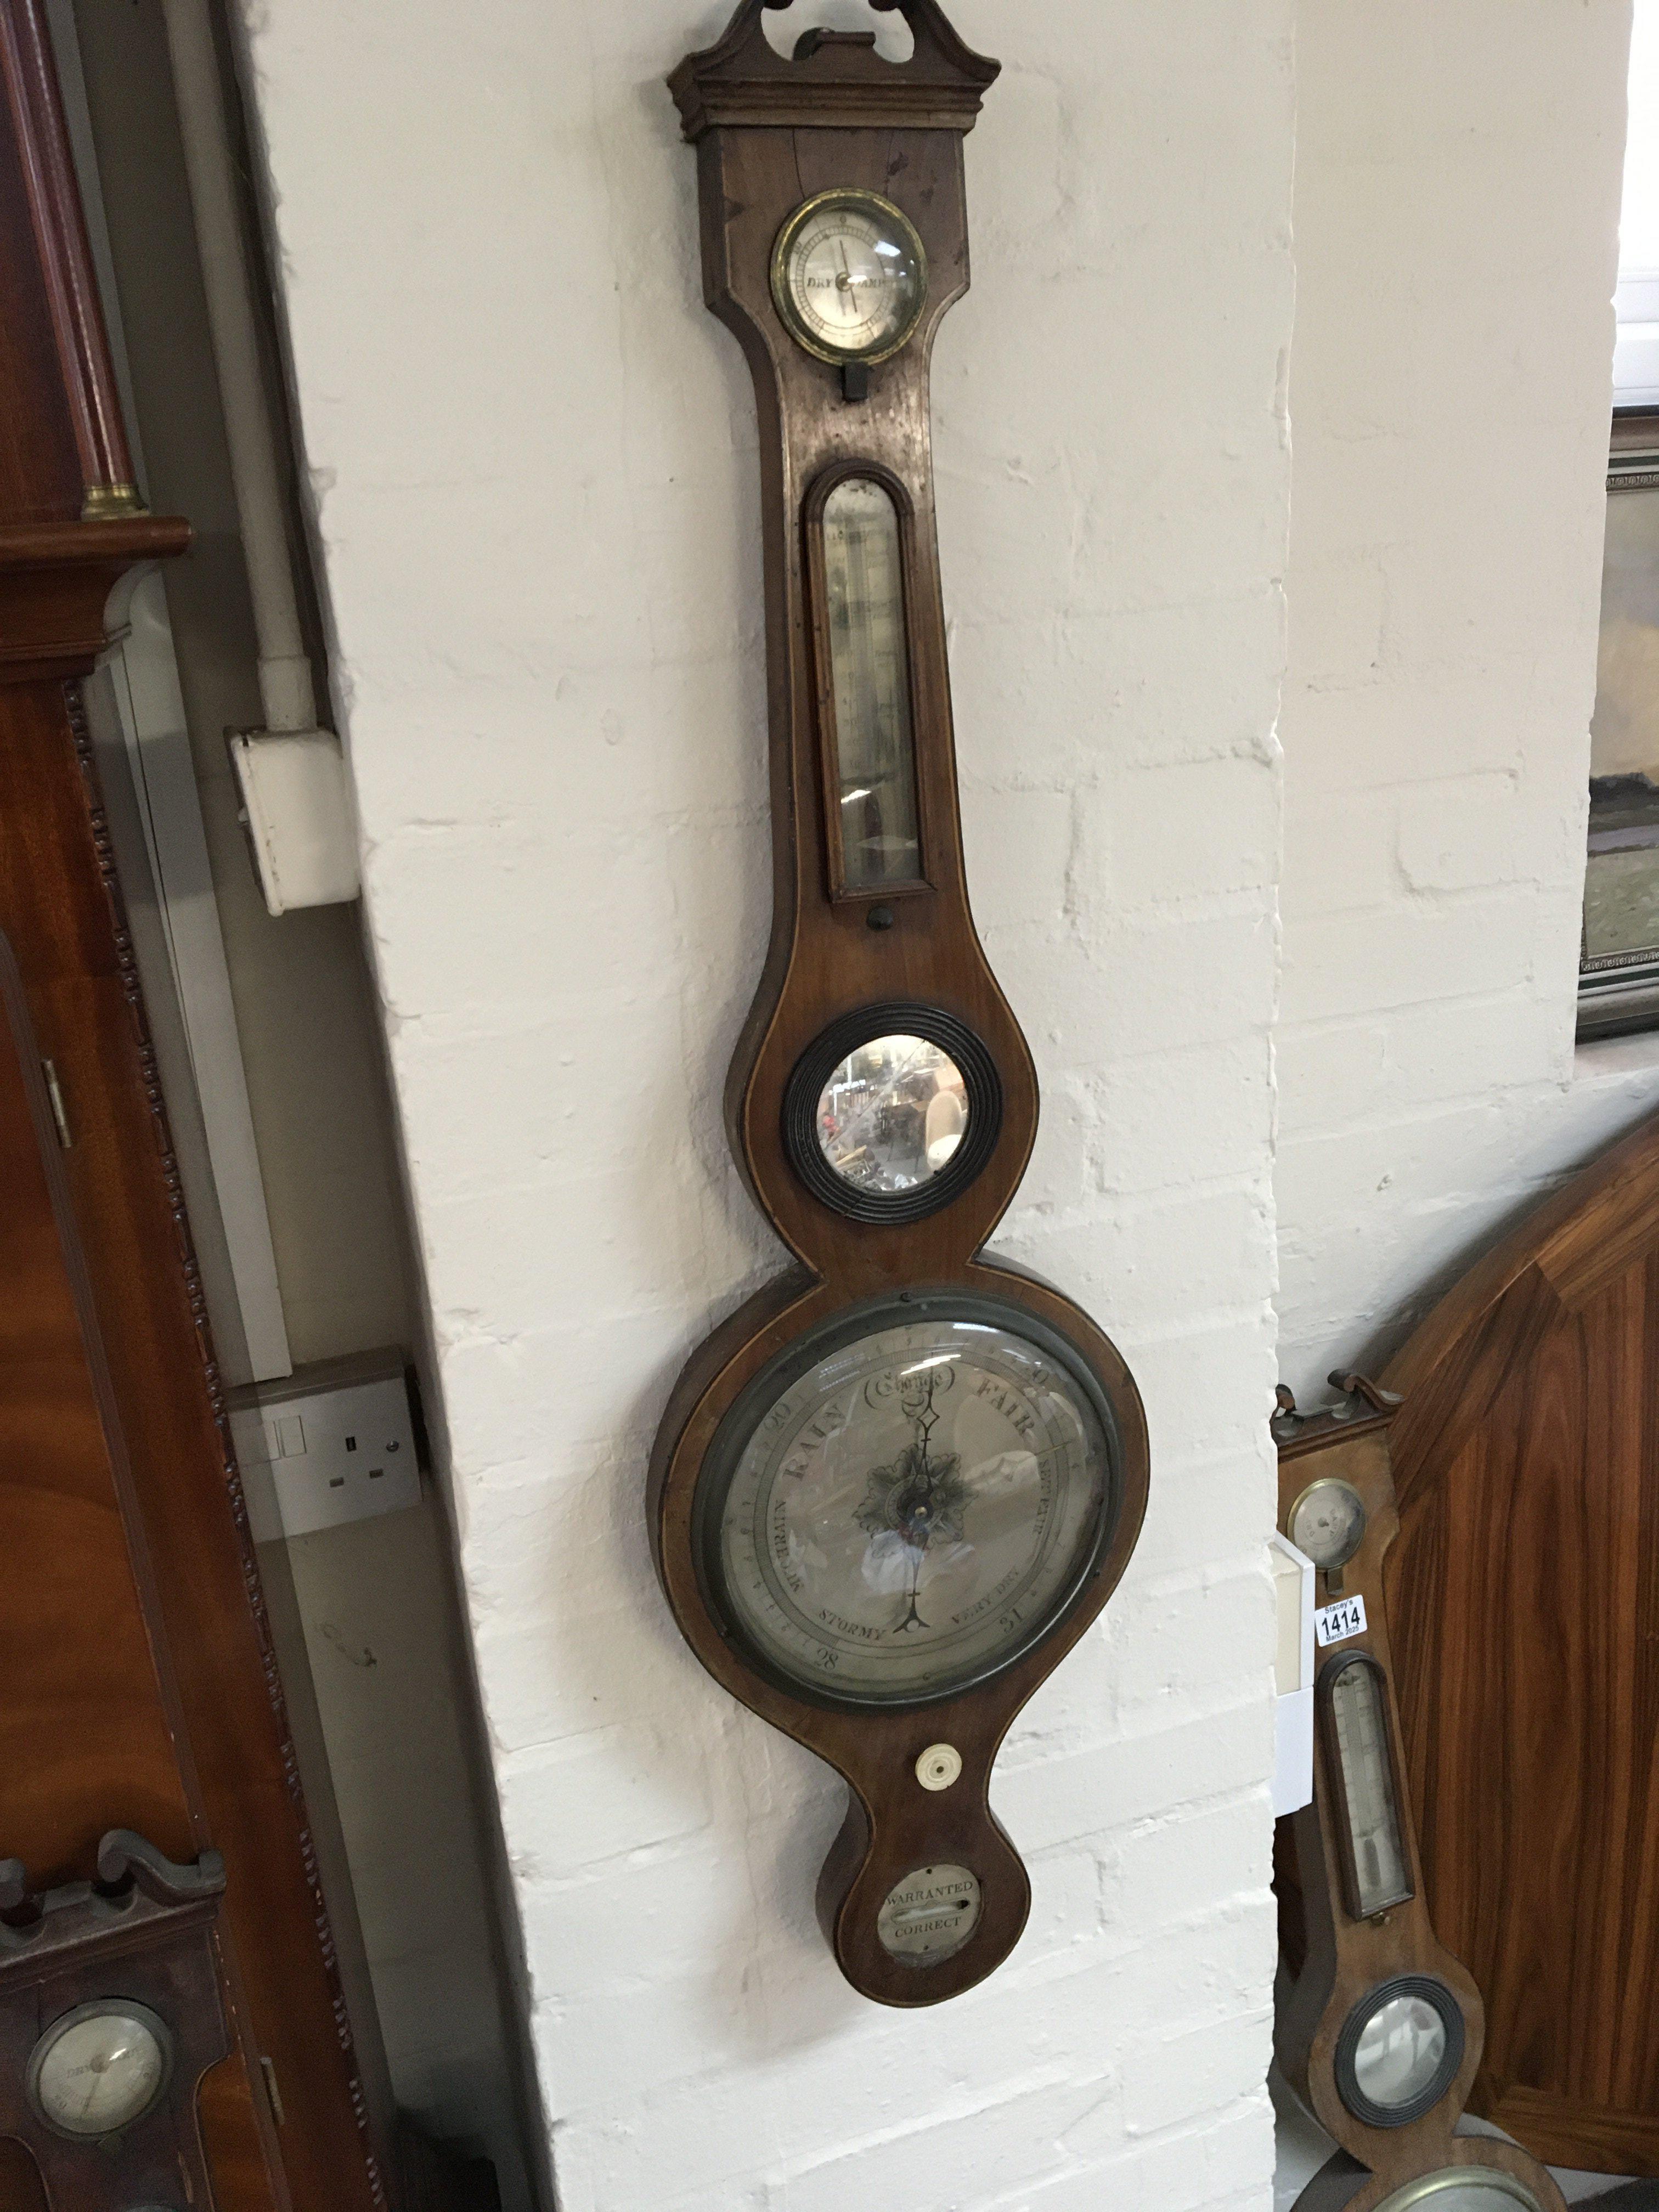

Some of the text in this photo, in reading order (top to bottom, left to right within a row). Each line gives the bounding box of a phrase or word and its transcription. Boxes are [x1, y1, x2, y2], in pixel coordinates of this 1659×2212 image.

[807, 277, 885, 288] DRY AMP
[976, 1377, 1035, 1436] FAIR
[782, 1403, 846, 1481] RAIN
[1324, 1599, 1354, 1615] Stacey's
[819, 1609, 888, 1641] STORMY
[1322, 1606, 1361, 1636] 1414
[1325, 1625, 1359, 1642] March 2025
[814, 1647, 839, 1670] 28
[887, 1881, 974, 1906] WARRANTED
[894, 1917, 962, 1938] CORRECT
